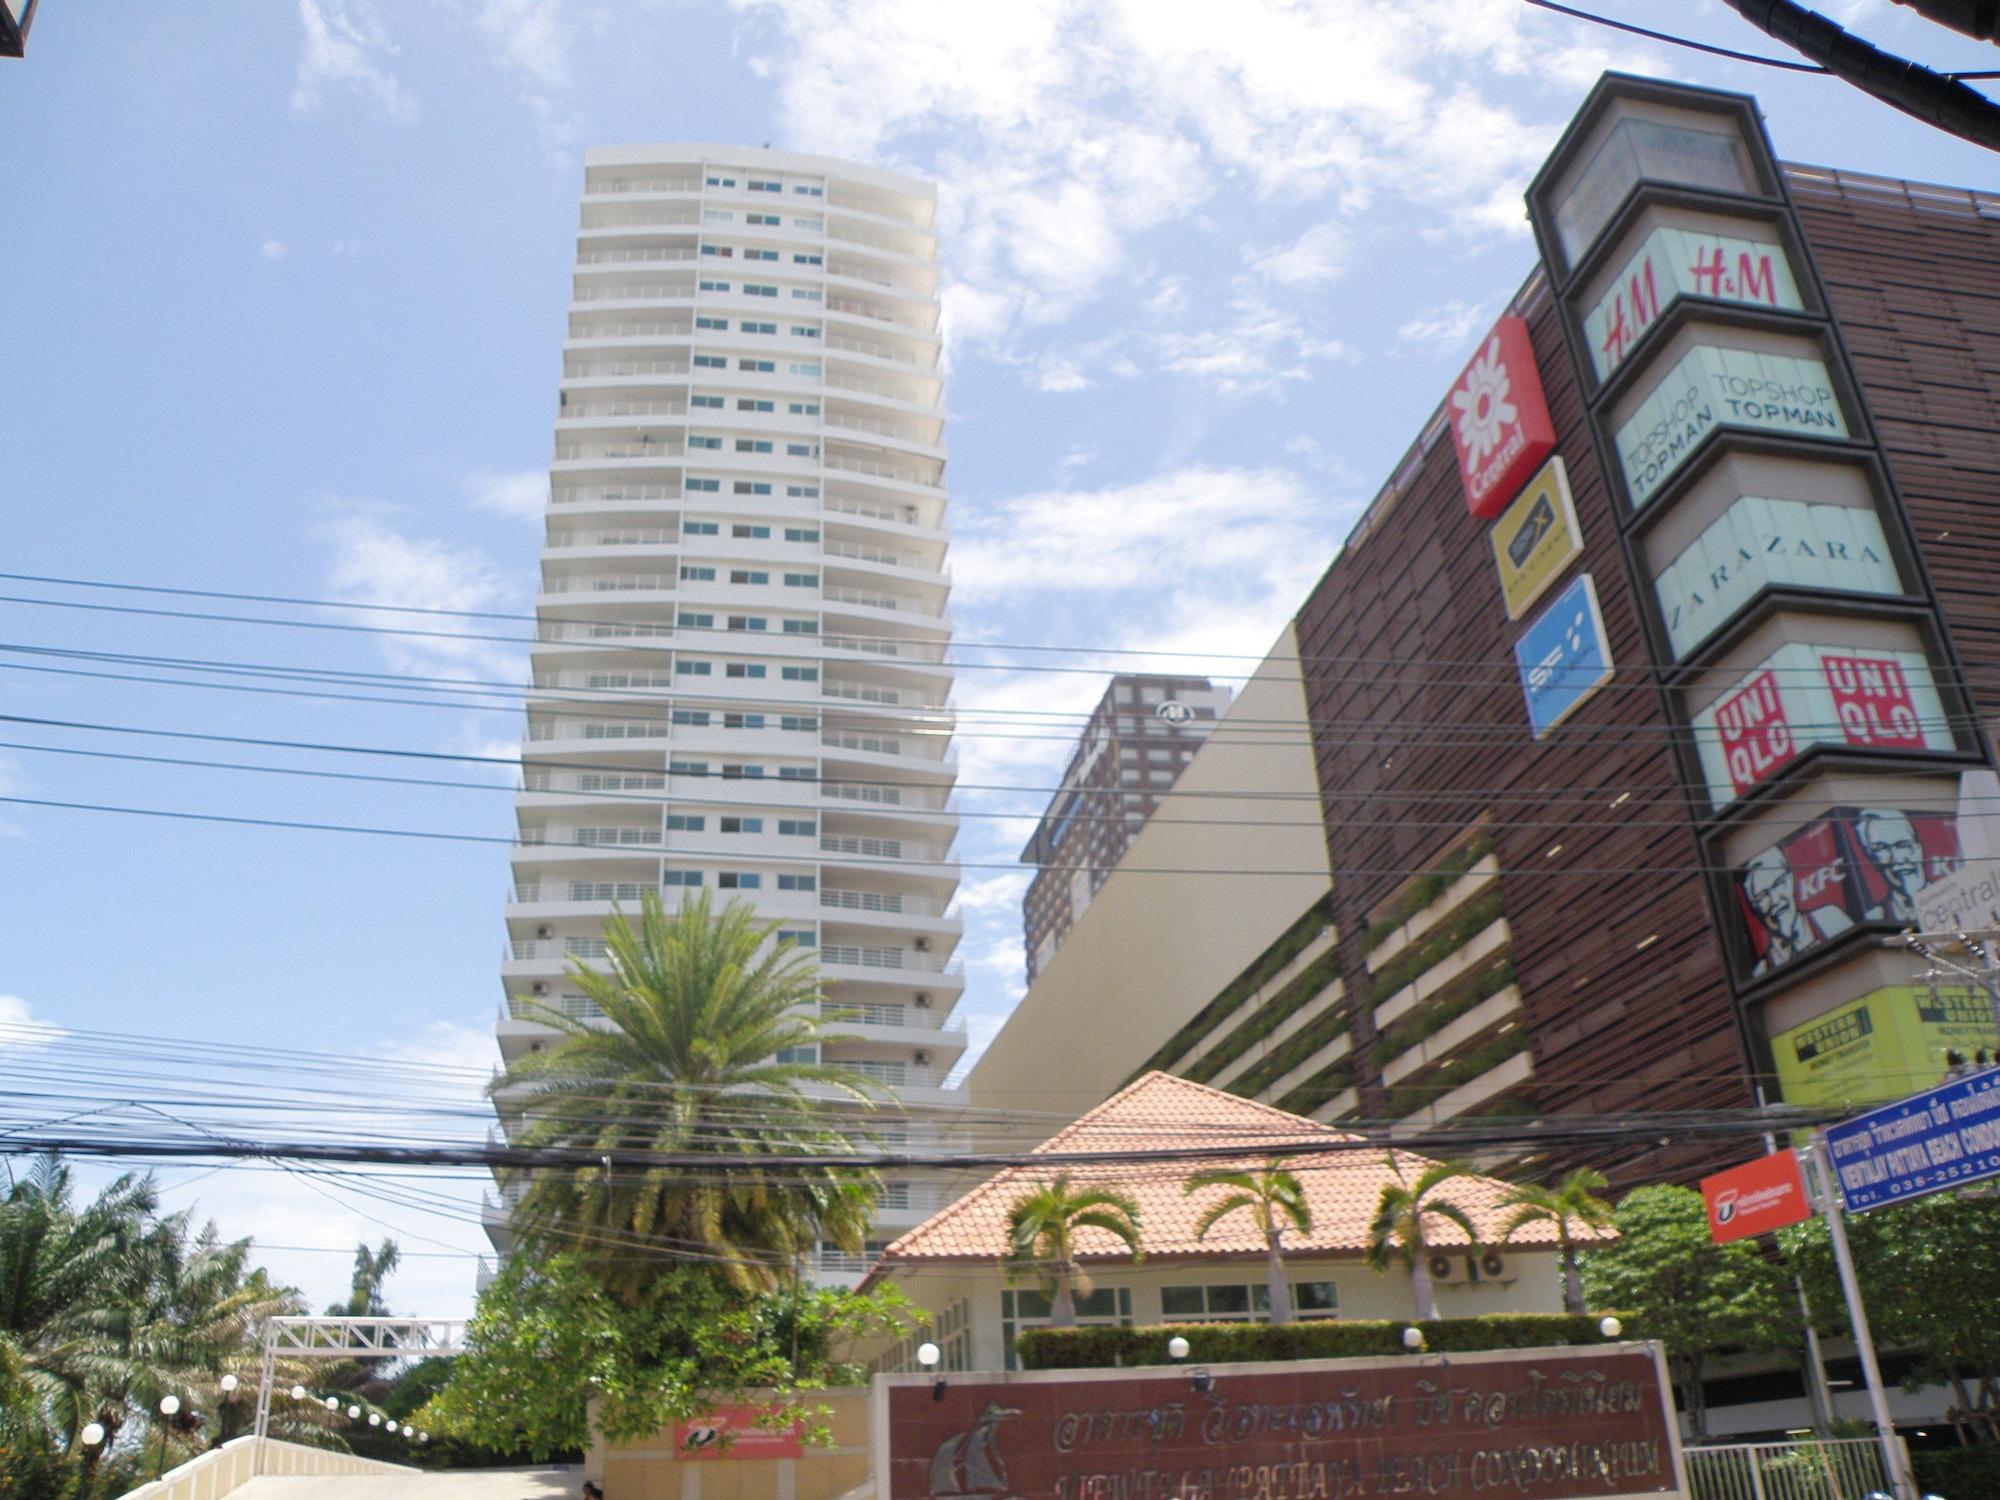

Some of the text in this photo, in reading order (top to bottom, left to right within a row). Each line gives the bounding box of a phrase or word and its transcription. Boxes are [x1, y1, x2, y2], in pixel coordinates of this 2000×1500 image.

[1690, 246, 1776, 308] H&M
[1604, 256, 1659, 371] H&M
[1712, 373, 1832, 405] TOPSHOP
[1725, 399, 1837, 428] TOPMAN
[1628, 386, 1699, 473] TOPSHOP
[1633, 404, 1713, 493] TOPMAN
[1763, 534, 1880, 564] ZARA
[1667, 548, 1753, 632] ZARA
[1720, 678, 1777, 742] UNI
[1826, 659, 1904, 699] UNI
[1729, 719, 1790, 785] QLO
[1839, 701, 1919, 745] QLO
[1800, 857, 1847, 901] KFC
